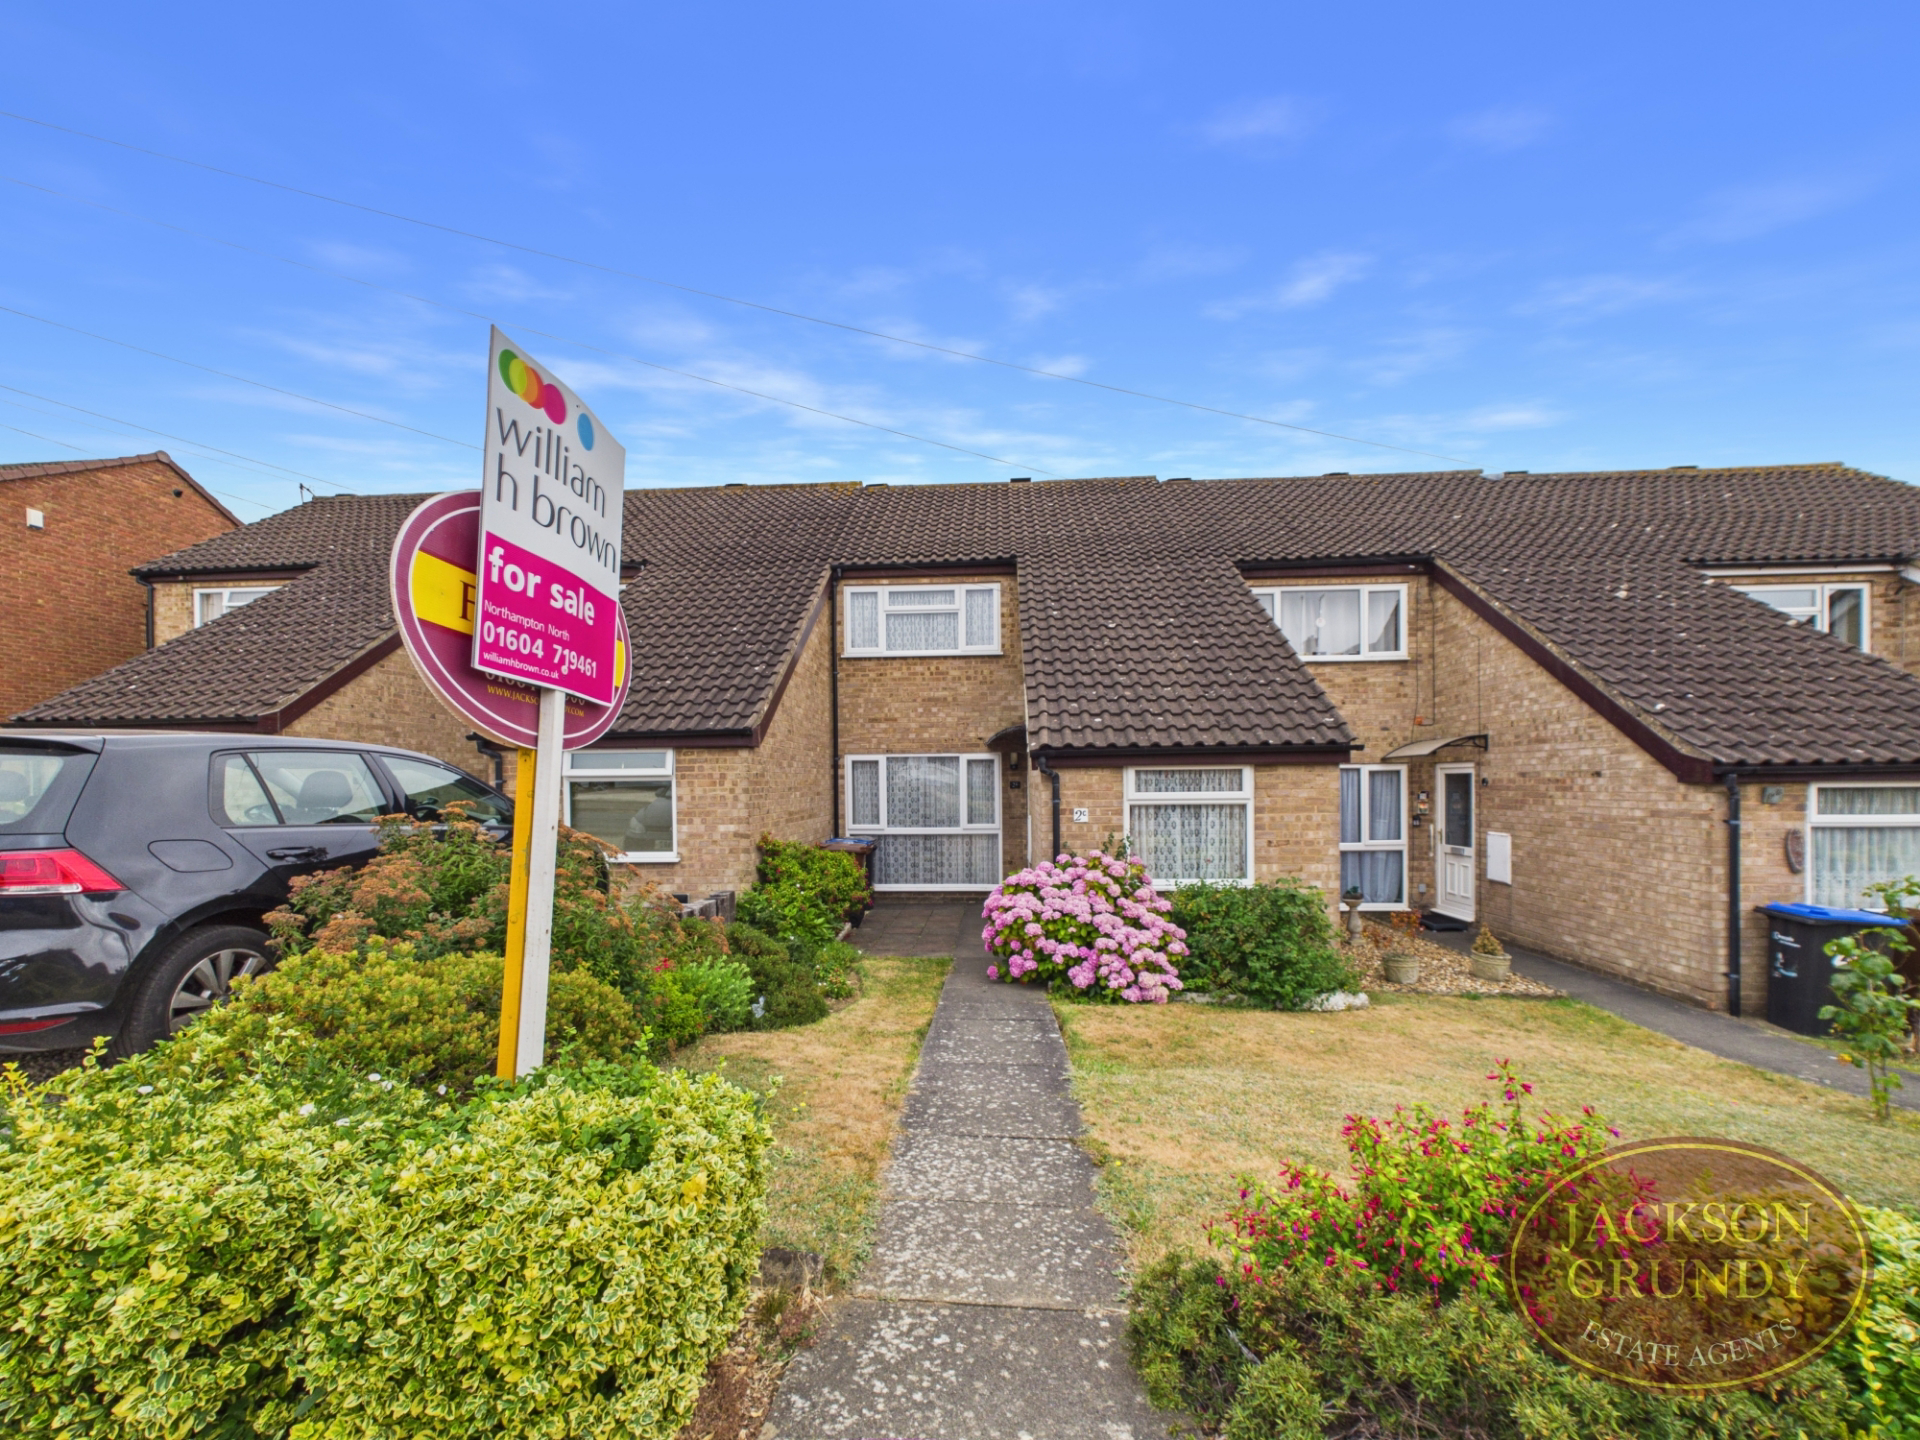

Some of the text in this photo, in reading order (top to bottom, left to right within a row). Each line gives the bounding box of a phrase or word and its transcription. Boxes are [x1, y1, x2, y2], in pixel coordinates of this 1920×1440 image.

[496, 407, 605, 518] william
[496, 452, 616, 573] h brown
[484, 599, 545, 633] Northampton
[548, 624, 570, 642] North
[489, 546, 595, 626] for sale
[483, 620, 597, 679] 01604 719461
[483, 652, 560, 680] williamhbrown.co.uk
